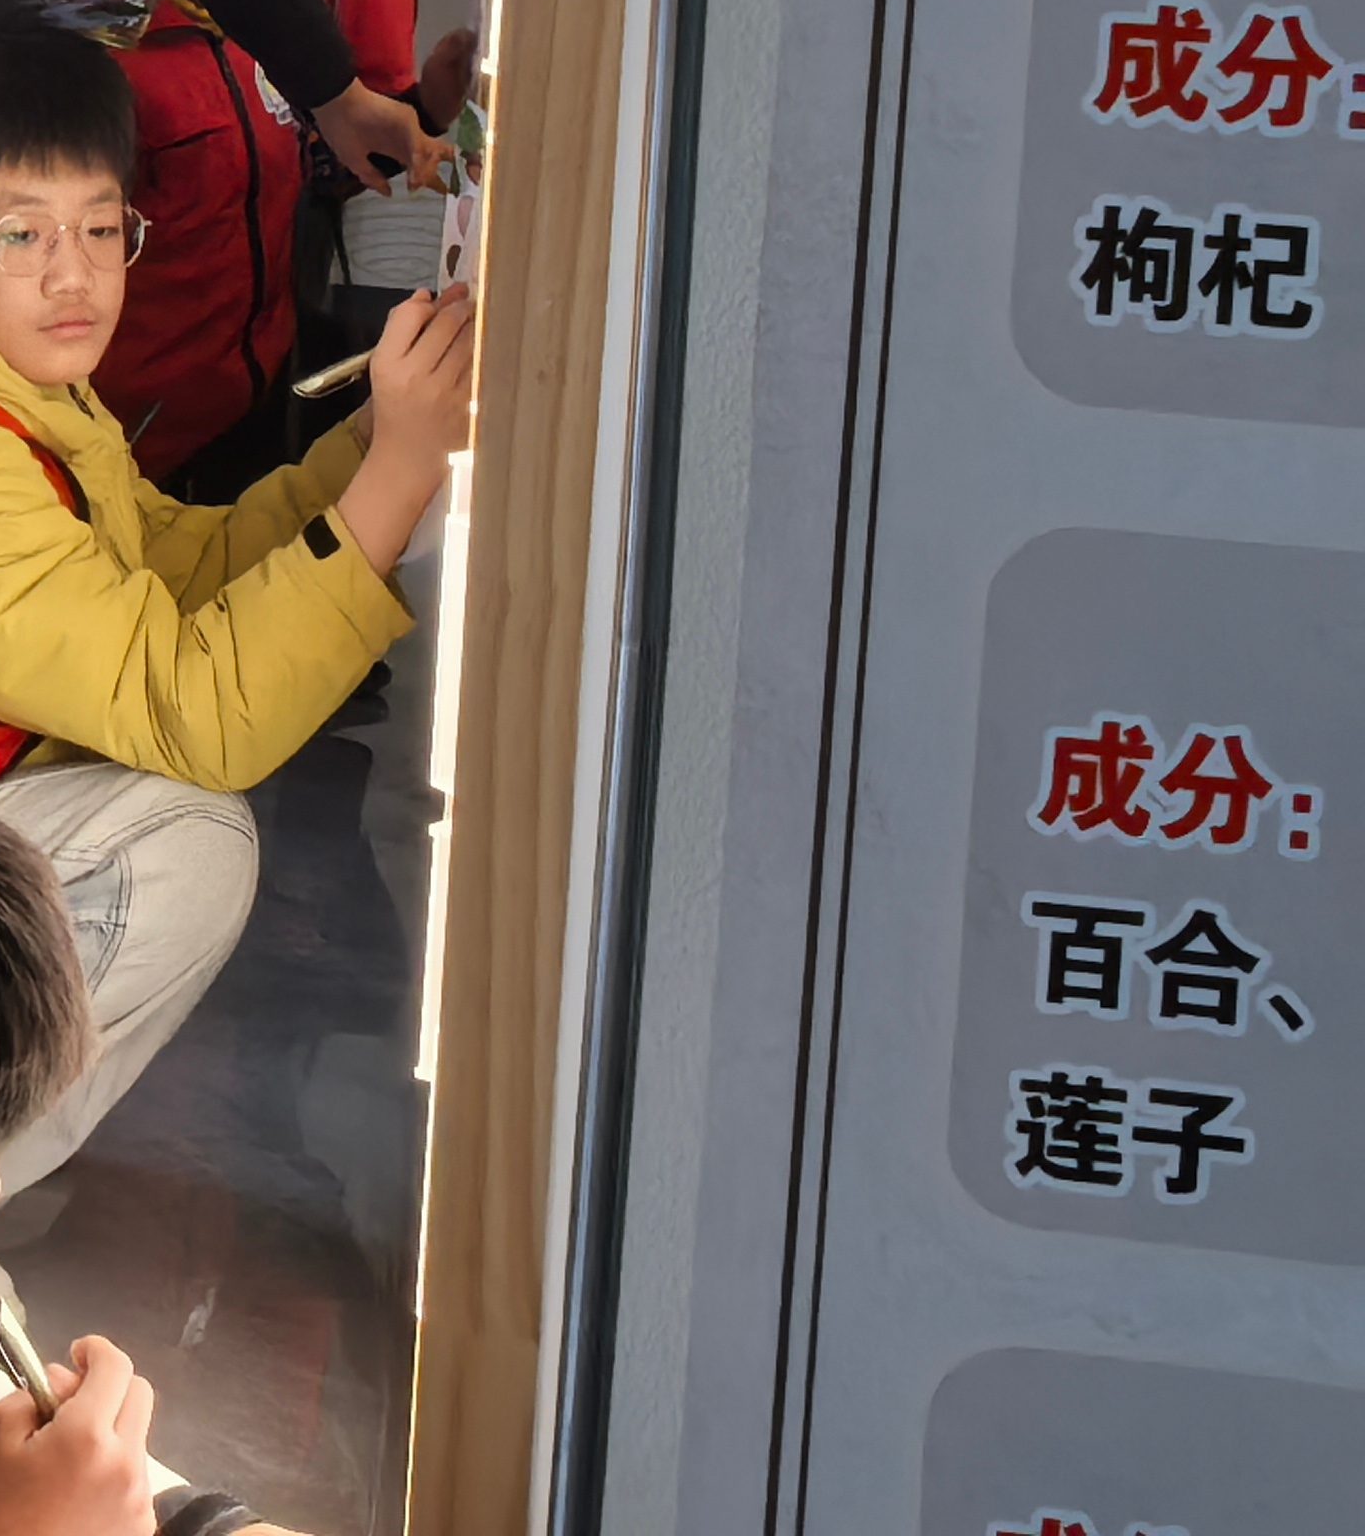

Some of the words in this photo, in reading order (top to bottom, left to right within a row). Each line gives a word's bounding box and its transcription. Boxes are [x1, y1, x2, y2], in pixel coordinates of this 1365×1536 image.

[1080, 205, 1312, 329] 枸杞
[1038, 721, 1312, 850] 成分：
[1031, 901, 1304, 1031] 百合、
[1015, 1071, 1246, 1195] 莲子
